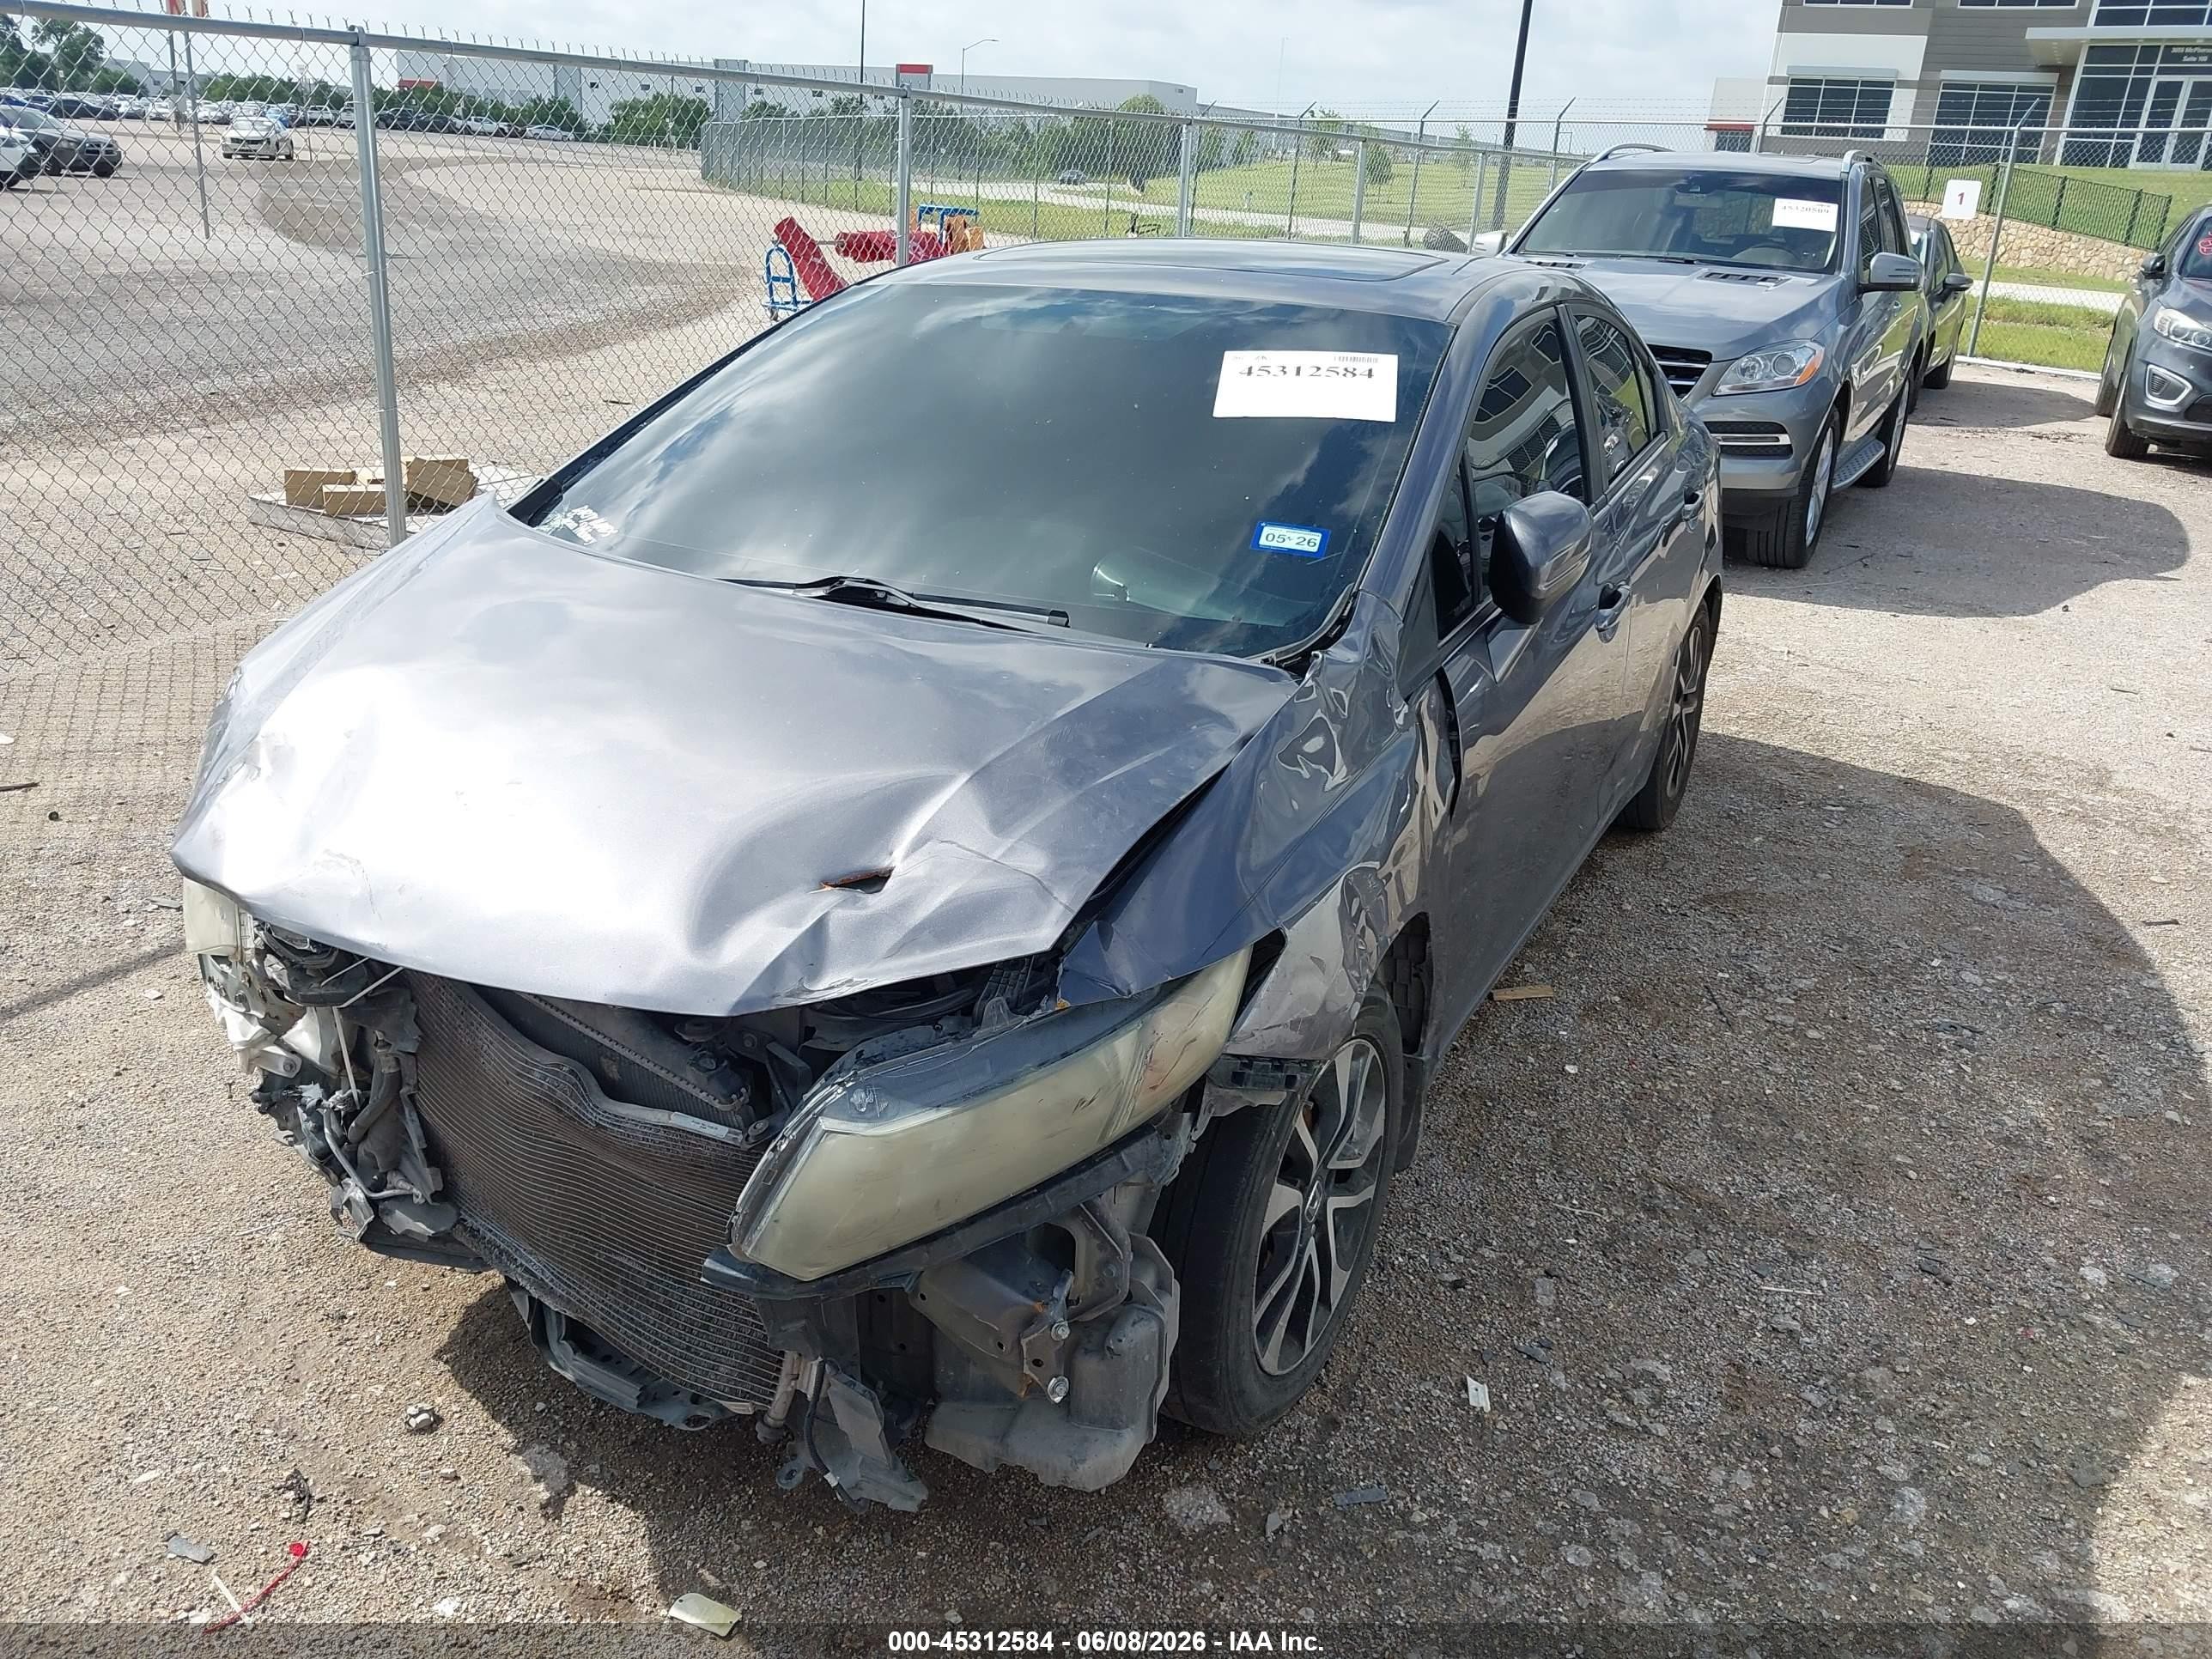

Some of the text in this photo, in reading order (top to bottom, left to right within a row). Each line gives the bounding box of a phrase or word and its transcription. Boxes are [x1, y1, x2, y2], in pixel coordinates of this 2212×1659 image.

[1957, 191, 1965, 205] 1
[1239, 365, 1375, 379] 45312584
[1265, 532, 1287, 544] 05
[1295, 536, 1317, 548] 26
